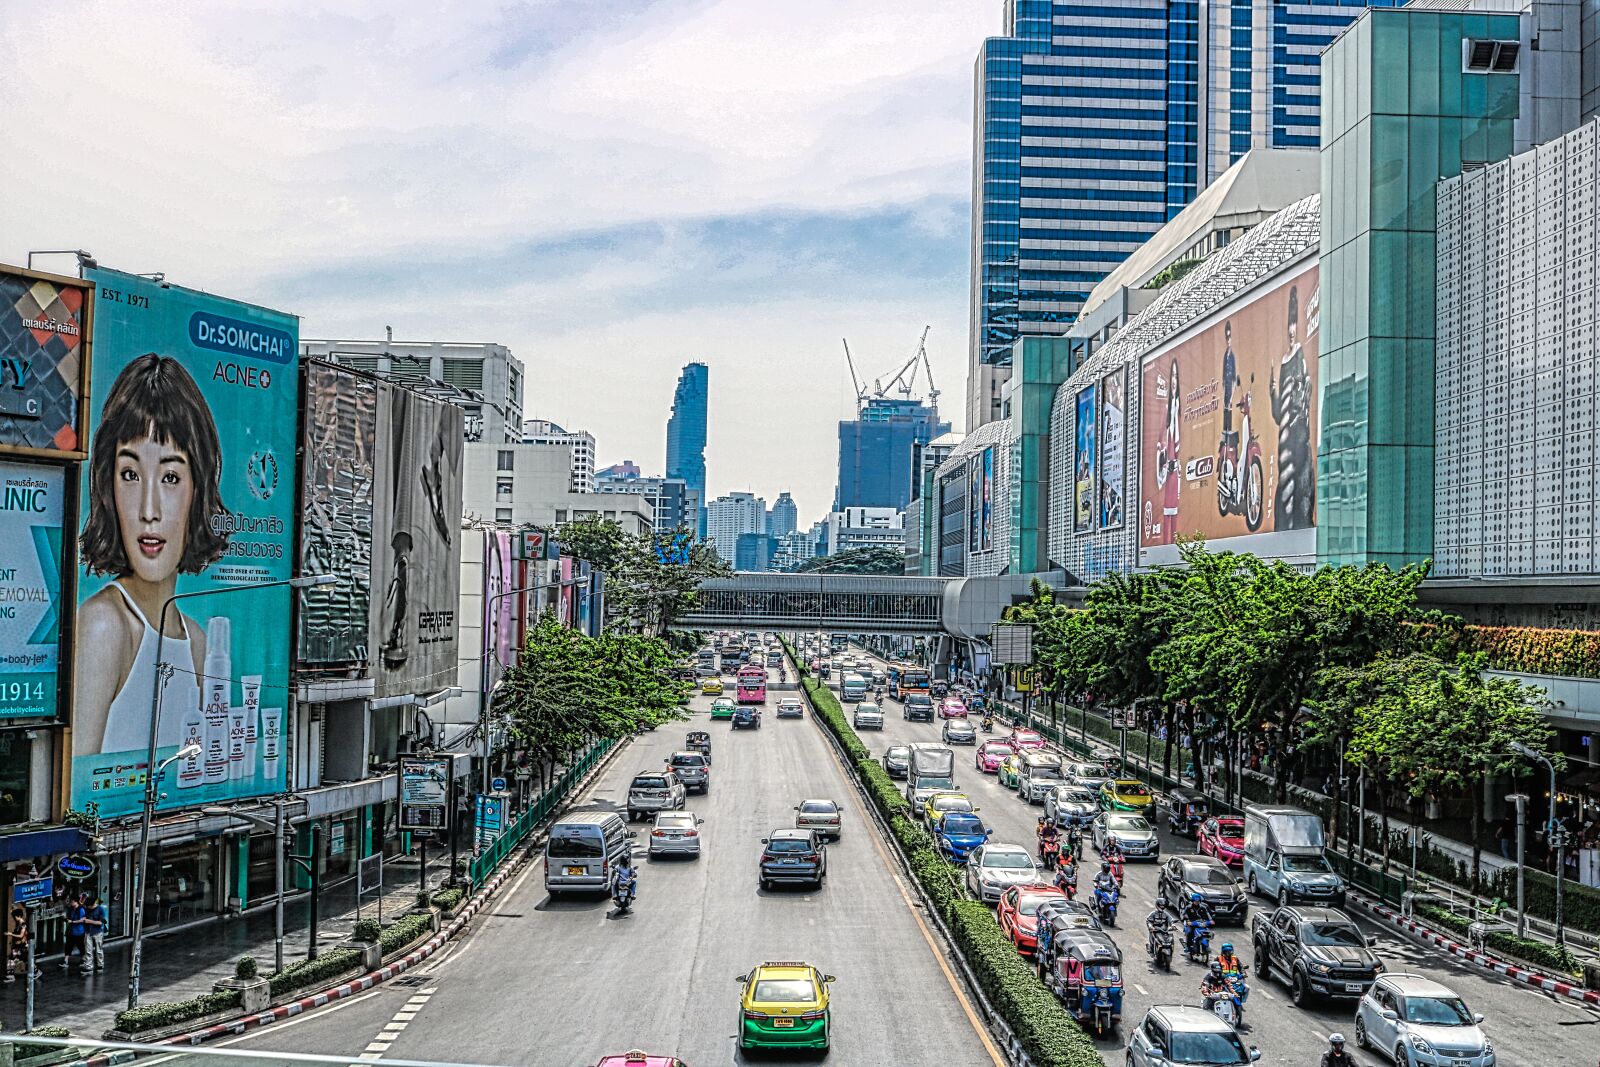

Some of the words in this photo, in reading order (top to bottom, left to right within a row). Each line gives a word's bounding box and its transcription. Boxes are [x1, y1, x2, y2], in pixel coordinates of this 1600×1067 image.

[102, 287, 123, 303] EST.
[127, 293, 149, 309] 1971
[212, 360, 258, 388] ACNE
[1197, 458, 1212, 476] Cub
[210, 512, 284, 537] ดูแลปัญหาสิว
[205, 702, 229, 715] ACNE
[244, 698, 259, 706] ACNE
[230, 727, 246, 736] ACNE
[184, 735, 202, 747] ACNE
